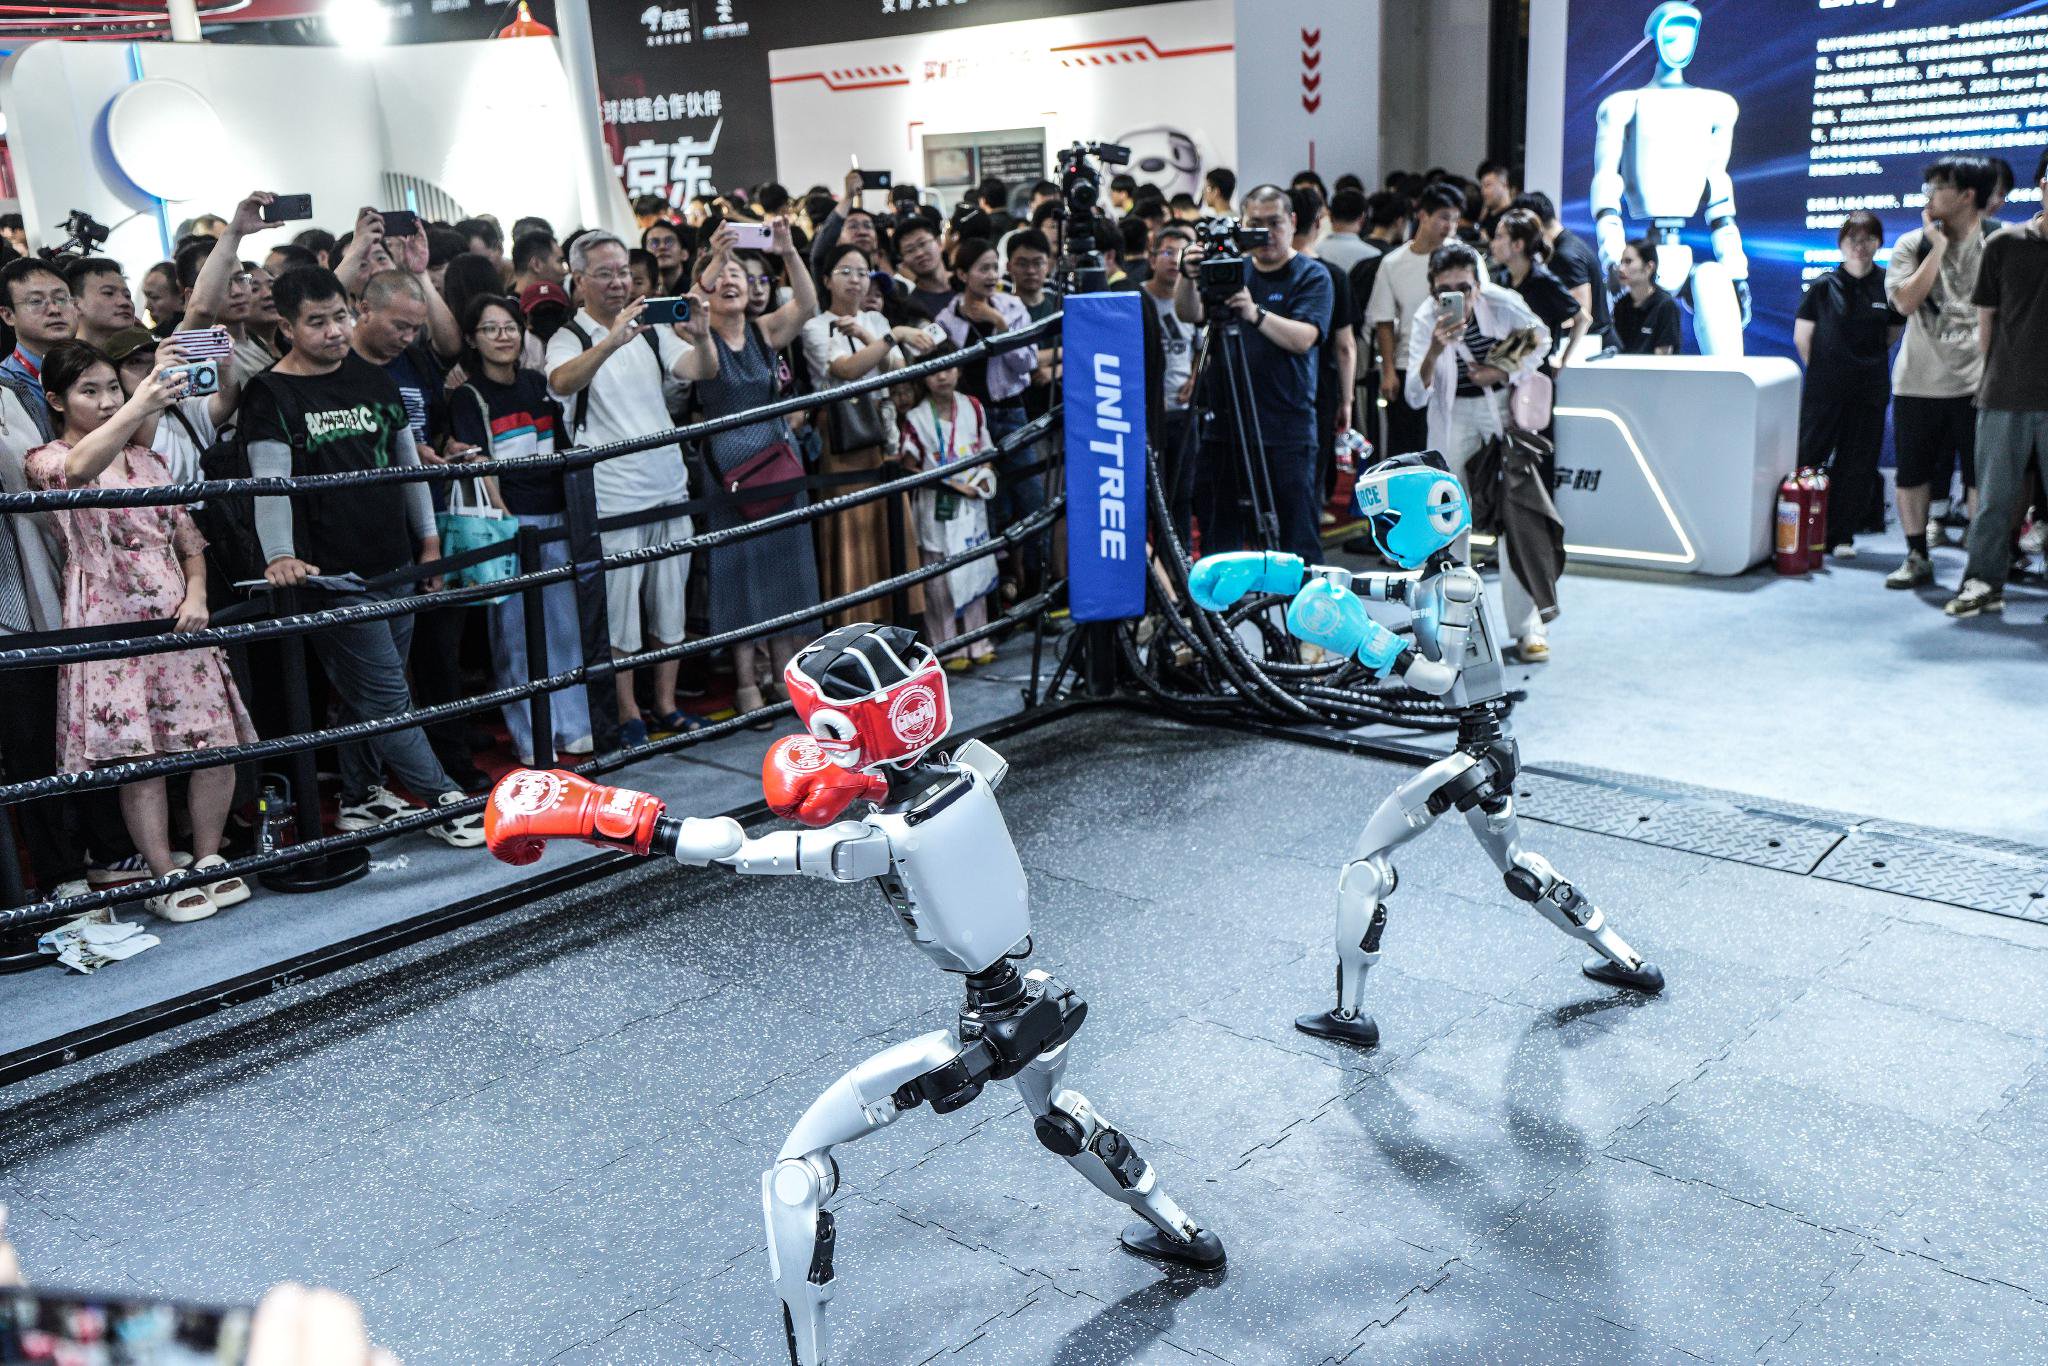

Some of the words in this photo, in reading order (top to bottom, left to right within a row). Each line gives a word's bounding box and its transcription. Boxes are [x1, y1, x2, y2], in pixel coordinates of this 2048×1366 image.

[600, 90, 722, 124] 球战略合作伙伴
[622, 116, 723, 208] 京东
[1090, 353, 1131, 561] UNITREE
[1553, 467, 1602, 492] 宇树
